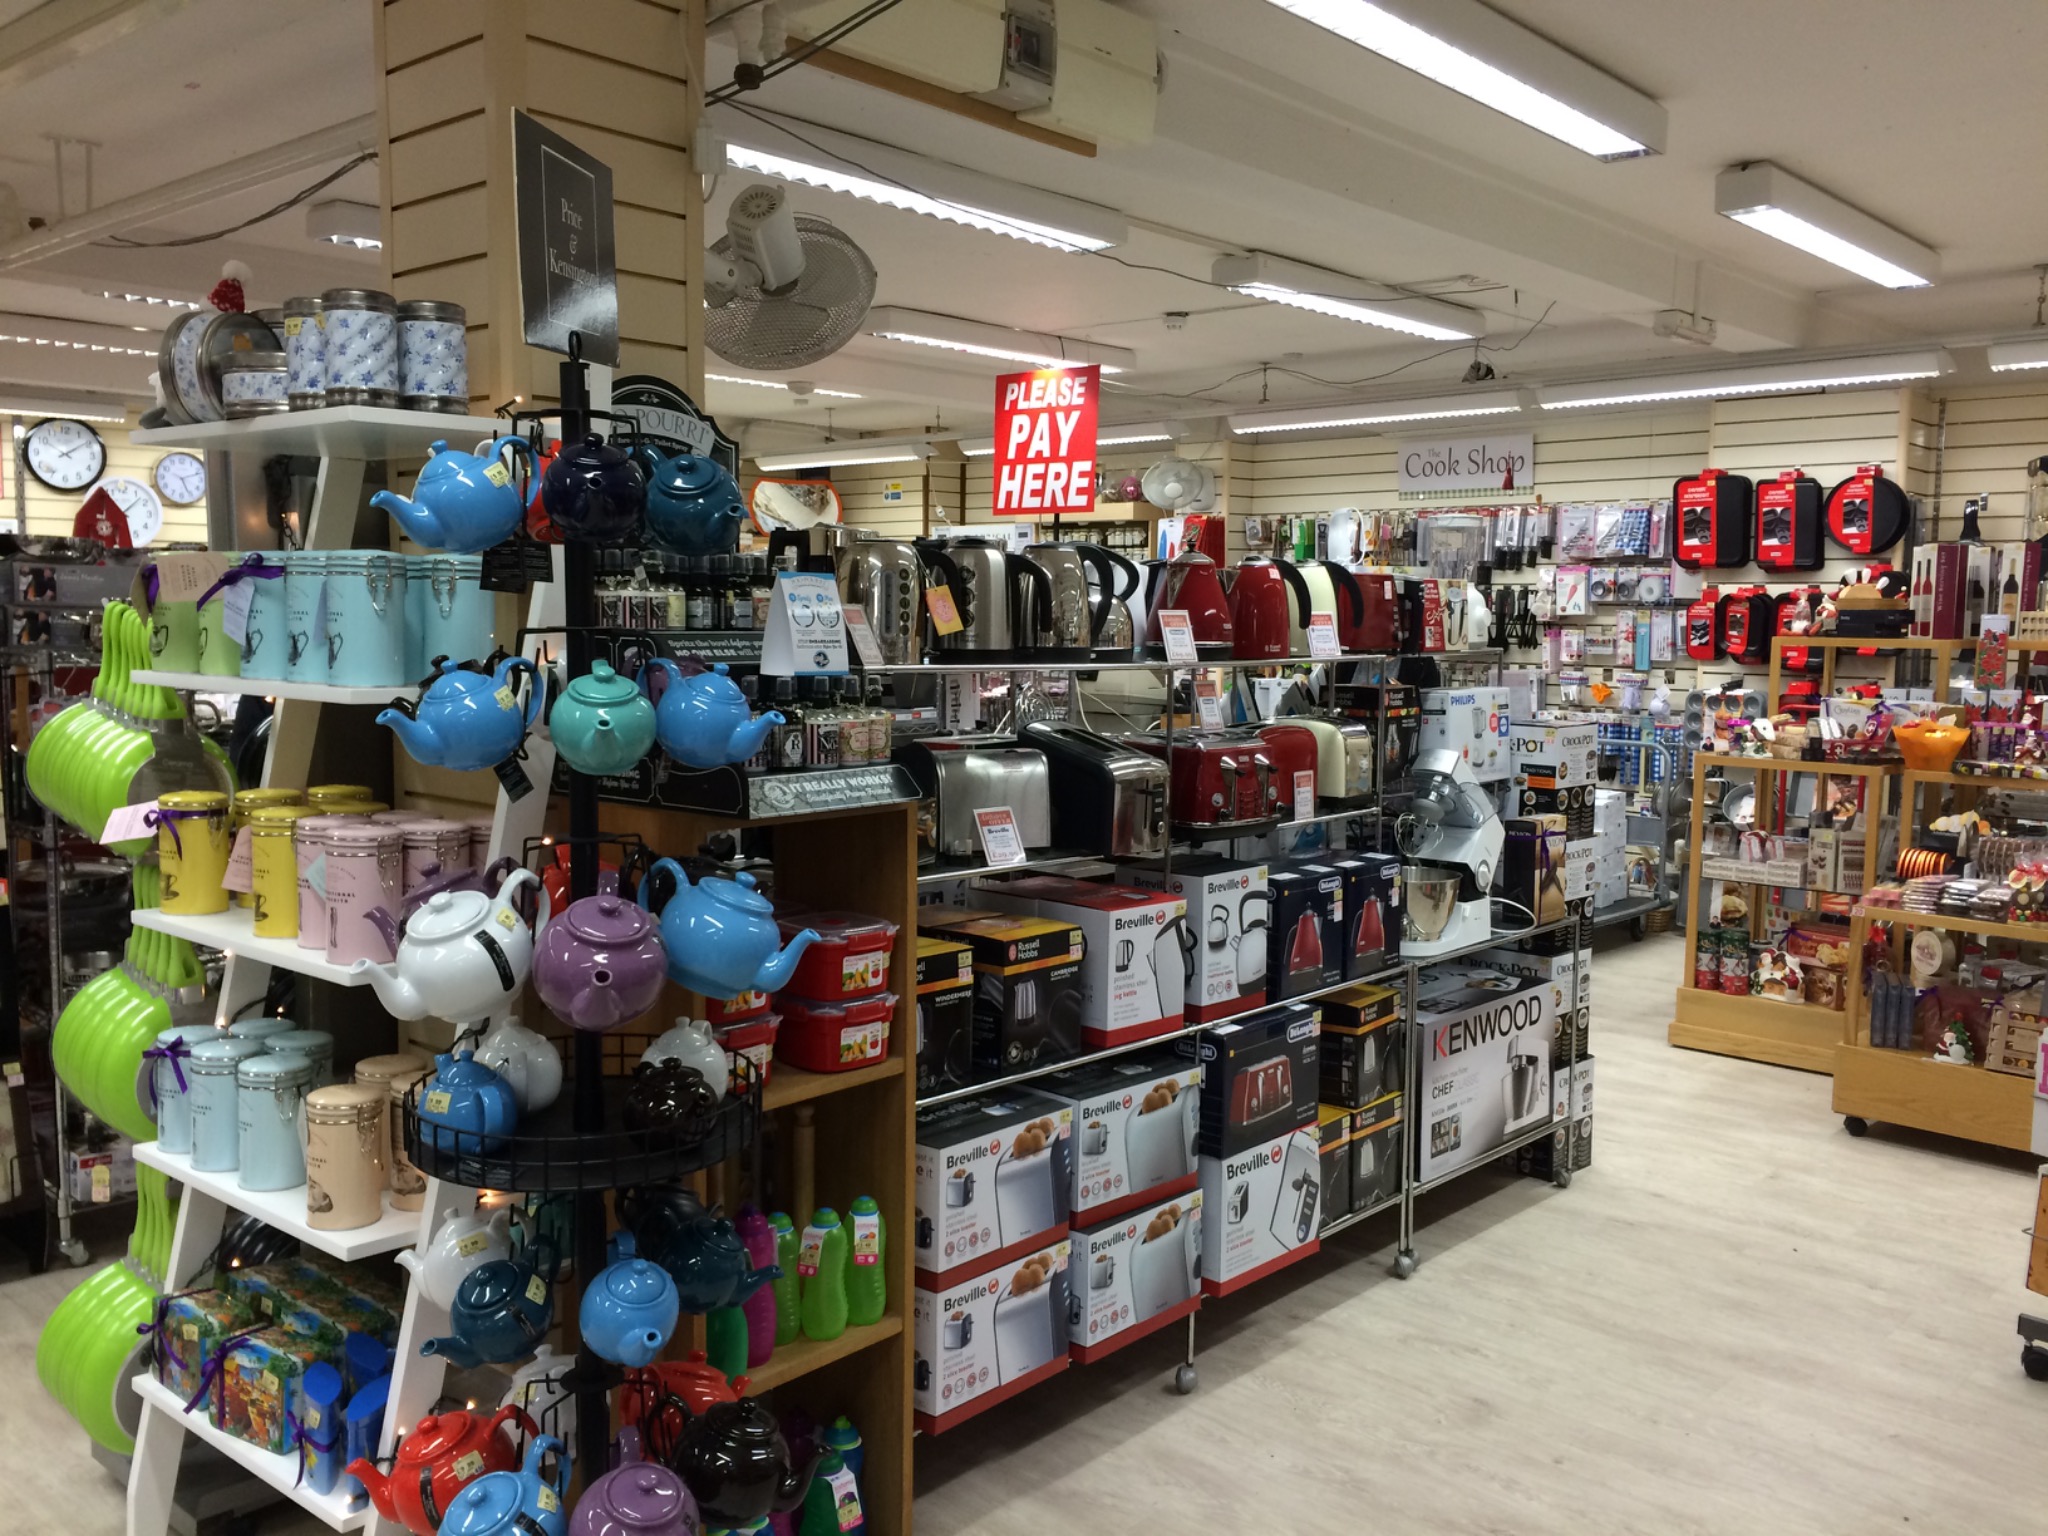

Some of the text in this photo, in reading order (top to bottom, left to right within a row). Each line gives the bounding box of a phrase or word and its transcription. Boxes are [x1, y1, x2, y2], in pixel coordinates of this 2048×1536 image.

[561, 197, 583, 230] Price
[1004, 376, 1087, 411] PLEASE
[1007, 410, 1081, 460] PAY
[1428, 448, 1441, 458] The
[1405, 445, 1525, 483] Cook Shop
[997, 460, 1092, 509] HERE
[1451, 694, 1476, 706] PHILIPS
[789, 773, 893, 794] IT REALLY WORKS!
[1208, 878, 1240, 894] Breville
[1115, 914, 1154, 931] Breville
[1018, 939, 1040, 951] Russell
[1018, 949, 1039, 960] Hobbs
[1051, 965, 1079, 978] CAMBRIDGE
[935, 989, 972, 1003] WINDERMERE
[1290, 1022, 1314, 1039] DeLongh
[1432, 995, 1542, 1062] KENWOOD
[1432, 1080, 1454, 1099] CHEF
[1082, 1100, 1122, 1120] Breville
[946, 1145, 989, 1169] Breville
[1226, 1152, 1270, 1181] Breville
[1091, 1232, 1127, 1254] Breville
[943, 1285, 987, 1312] Breville
